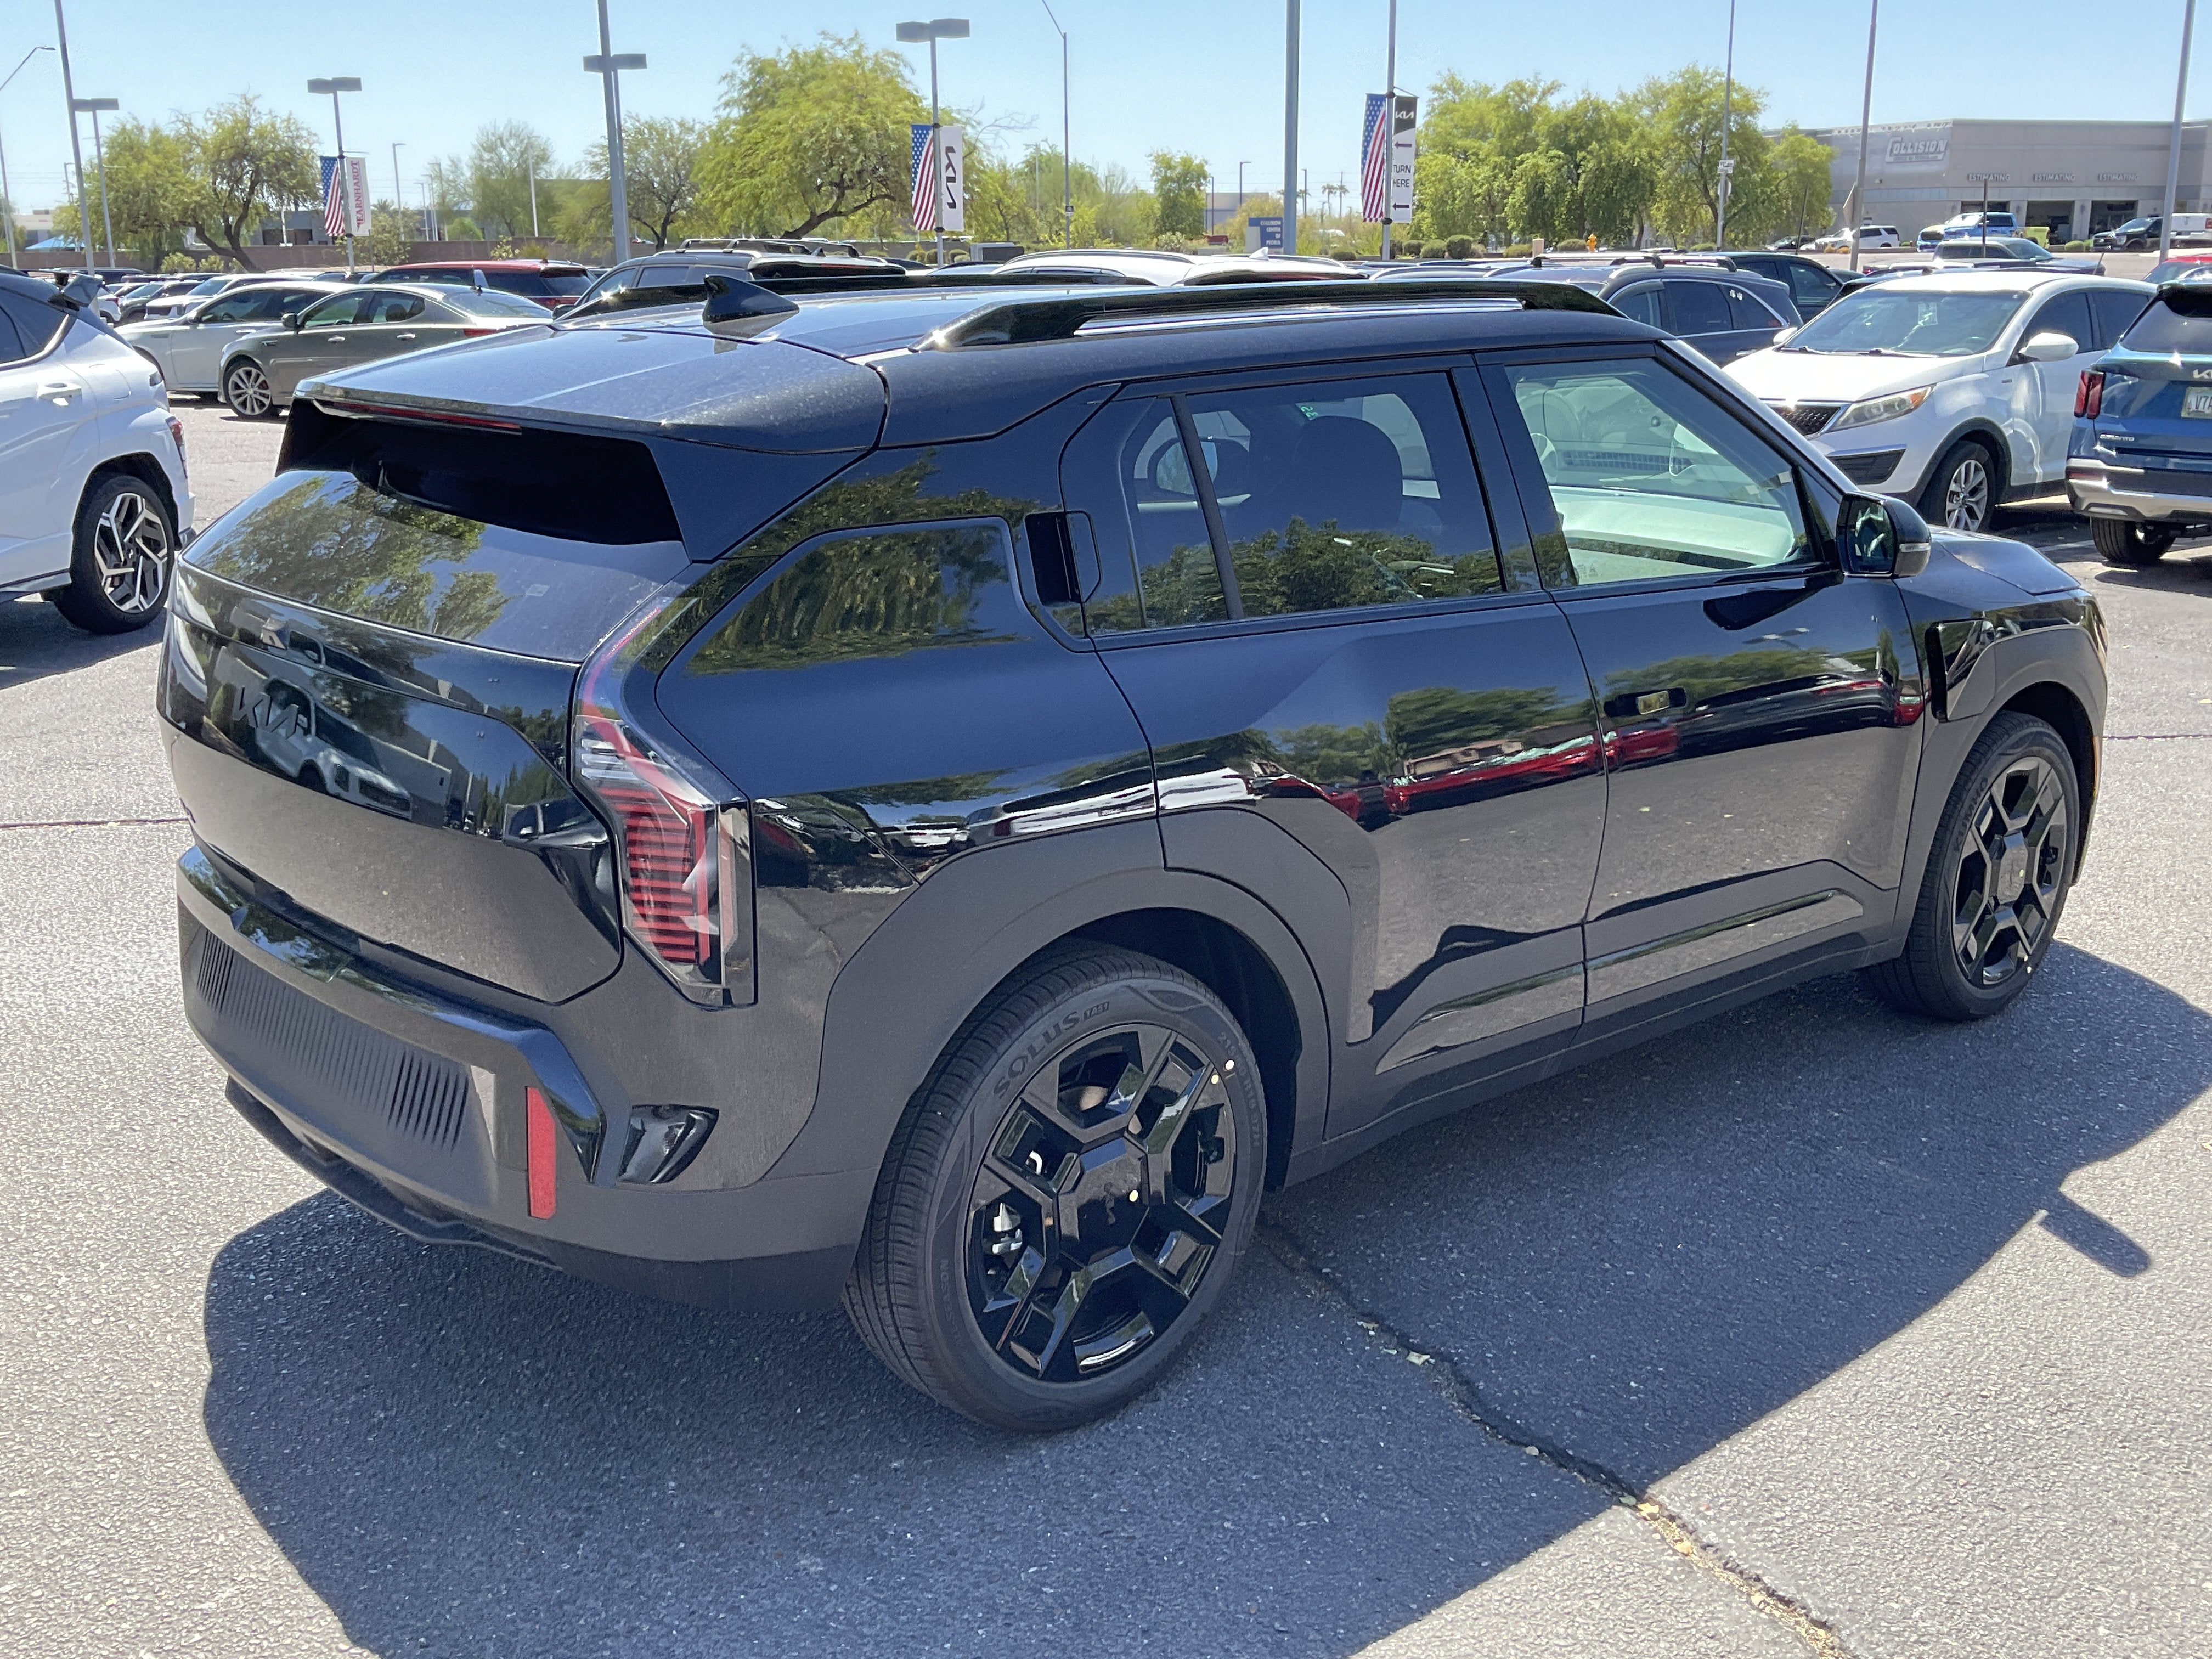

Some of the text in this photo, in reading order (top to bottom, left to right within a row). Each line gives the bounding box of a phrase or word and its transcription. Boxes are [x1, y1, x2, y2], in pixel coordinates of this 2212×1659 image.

[1395, 110, 1414, 119] KIA
[1886, 137, 1948, 162] COLLISION
[1393, 165, 1412, 174] TURN
[945, 146, 957, 210] KIA
[1967, 173, 2011, 182] ESTIMATING
[2033, 173, 2076, 182] ESTIMATING
[2098, 173, 2140, 182] ESTIMATING
[1393, 179, 1410, 188] HERE
[351, 160, 365, 230] EARNHARDT
[1954, 777, 1989, 851] KUMHO
[994, 1011, 1080, 1099] SOLUS
